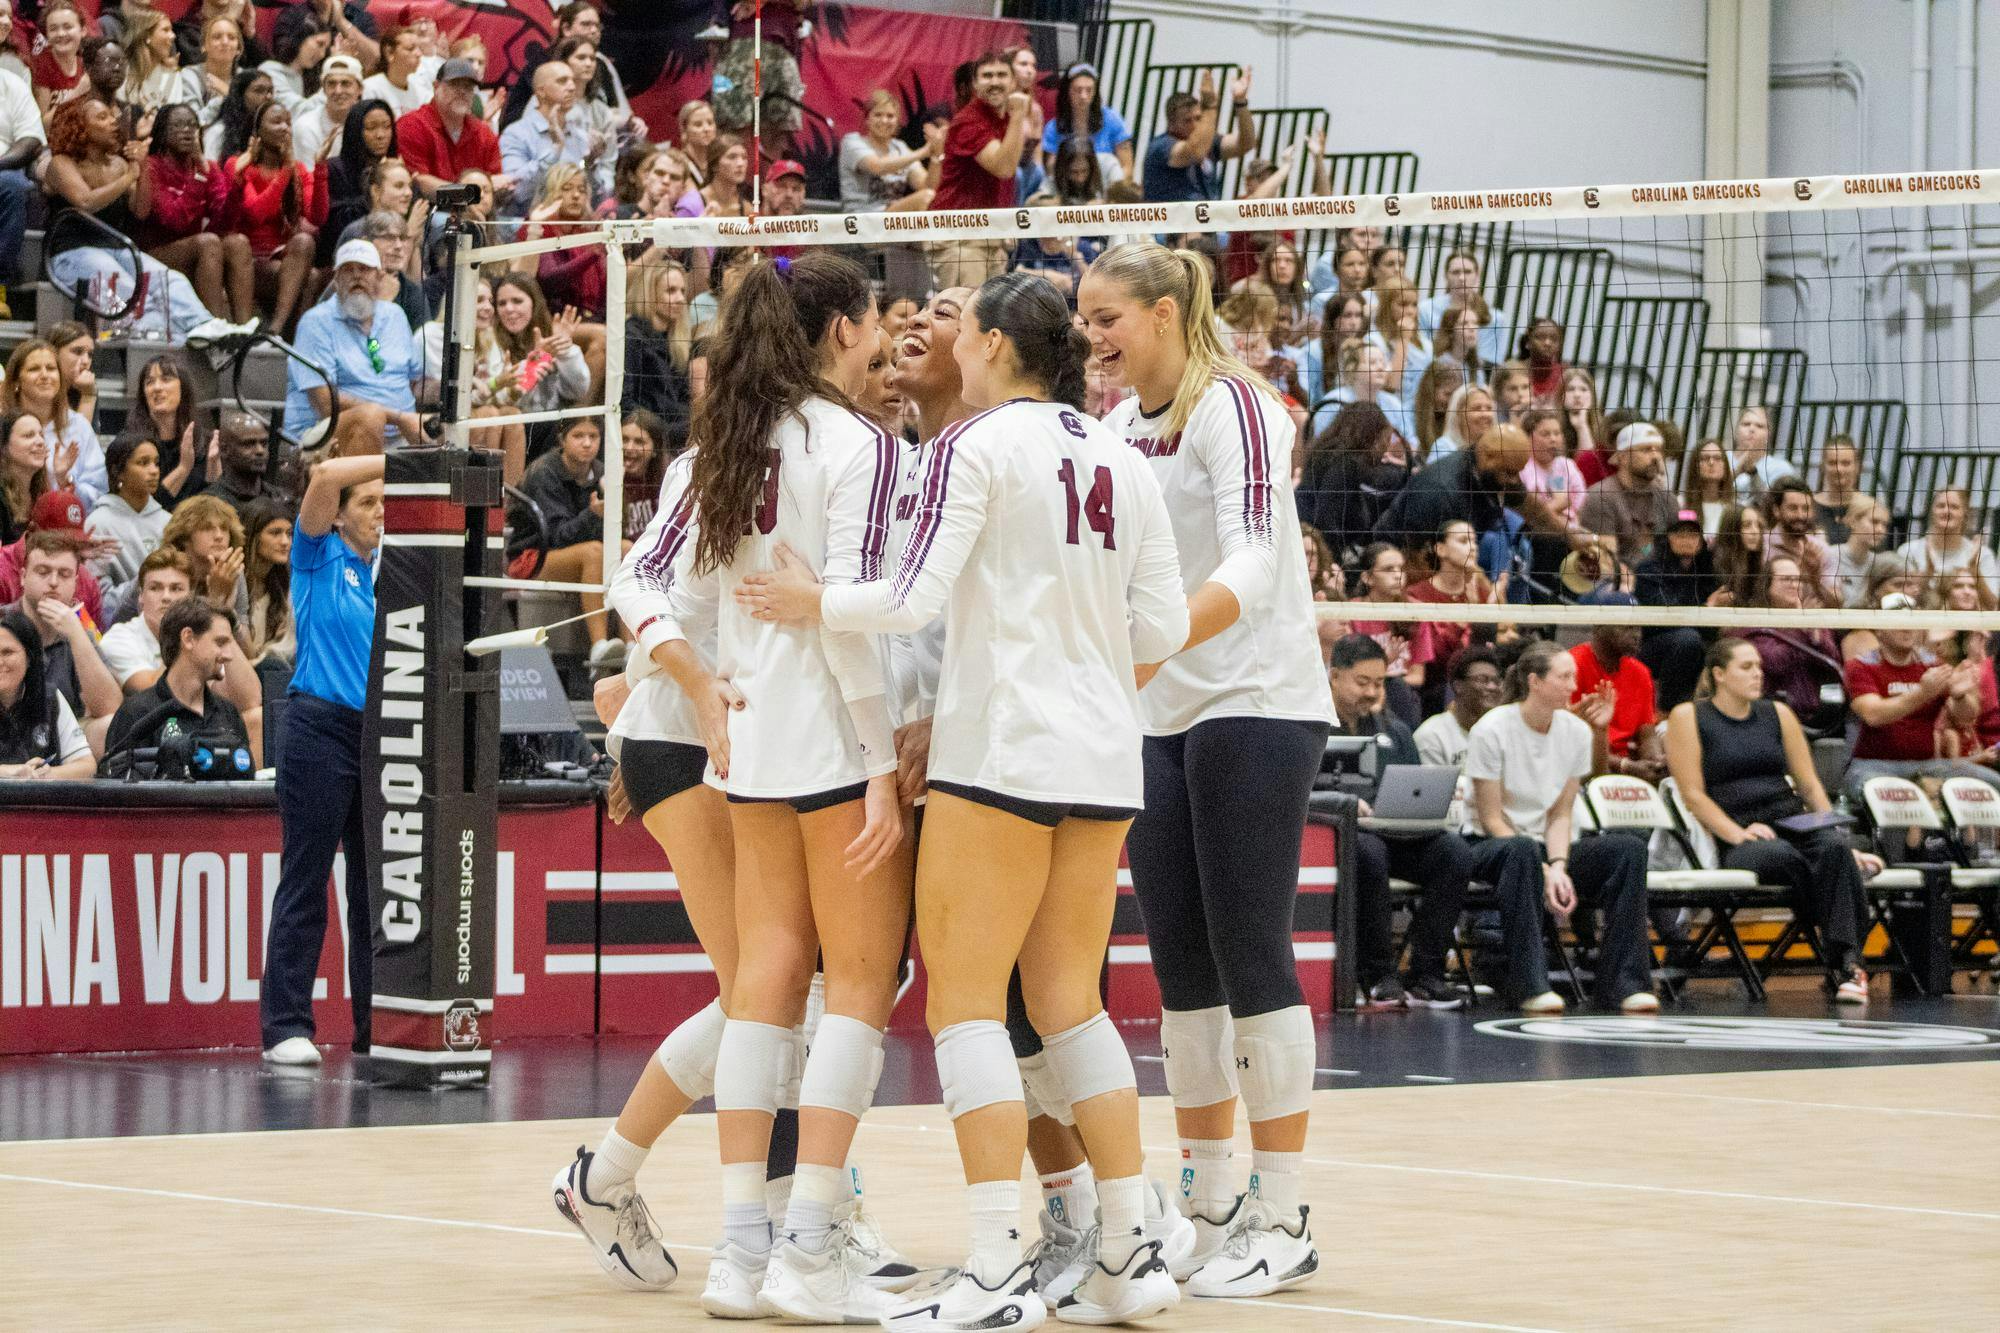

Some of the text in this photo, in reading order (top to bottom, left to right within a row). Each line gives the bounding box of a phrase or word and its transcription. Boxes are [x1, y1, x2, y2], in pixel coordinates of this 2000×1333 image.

[1631, 183, 1761, 203] CAROLINA GAMECOCKS
[1844, 174, 1981, 195] CAROLINA GAMECOCKS
[1238, 200, 1356, 218] CAROLINA GAMECOCKS
[1430, 192, 1553, 211] CAROLINA GAMECOCKS
[884, 214, 989, 231] CAROLINA GAMECOCKS
[1056, 207, 1167, 224] CAROLINA GAMECOCKS
[764, 219, 819, 234] GAMECOCKS
[1057, 458, 1117, 551] 14
[380, 604, 425, 943] CAROLINA
[456, 829, 474, 984] sports imports
